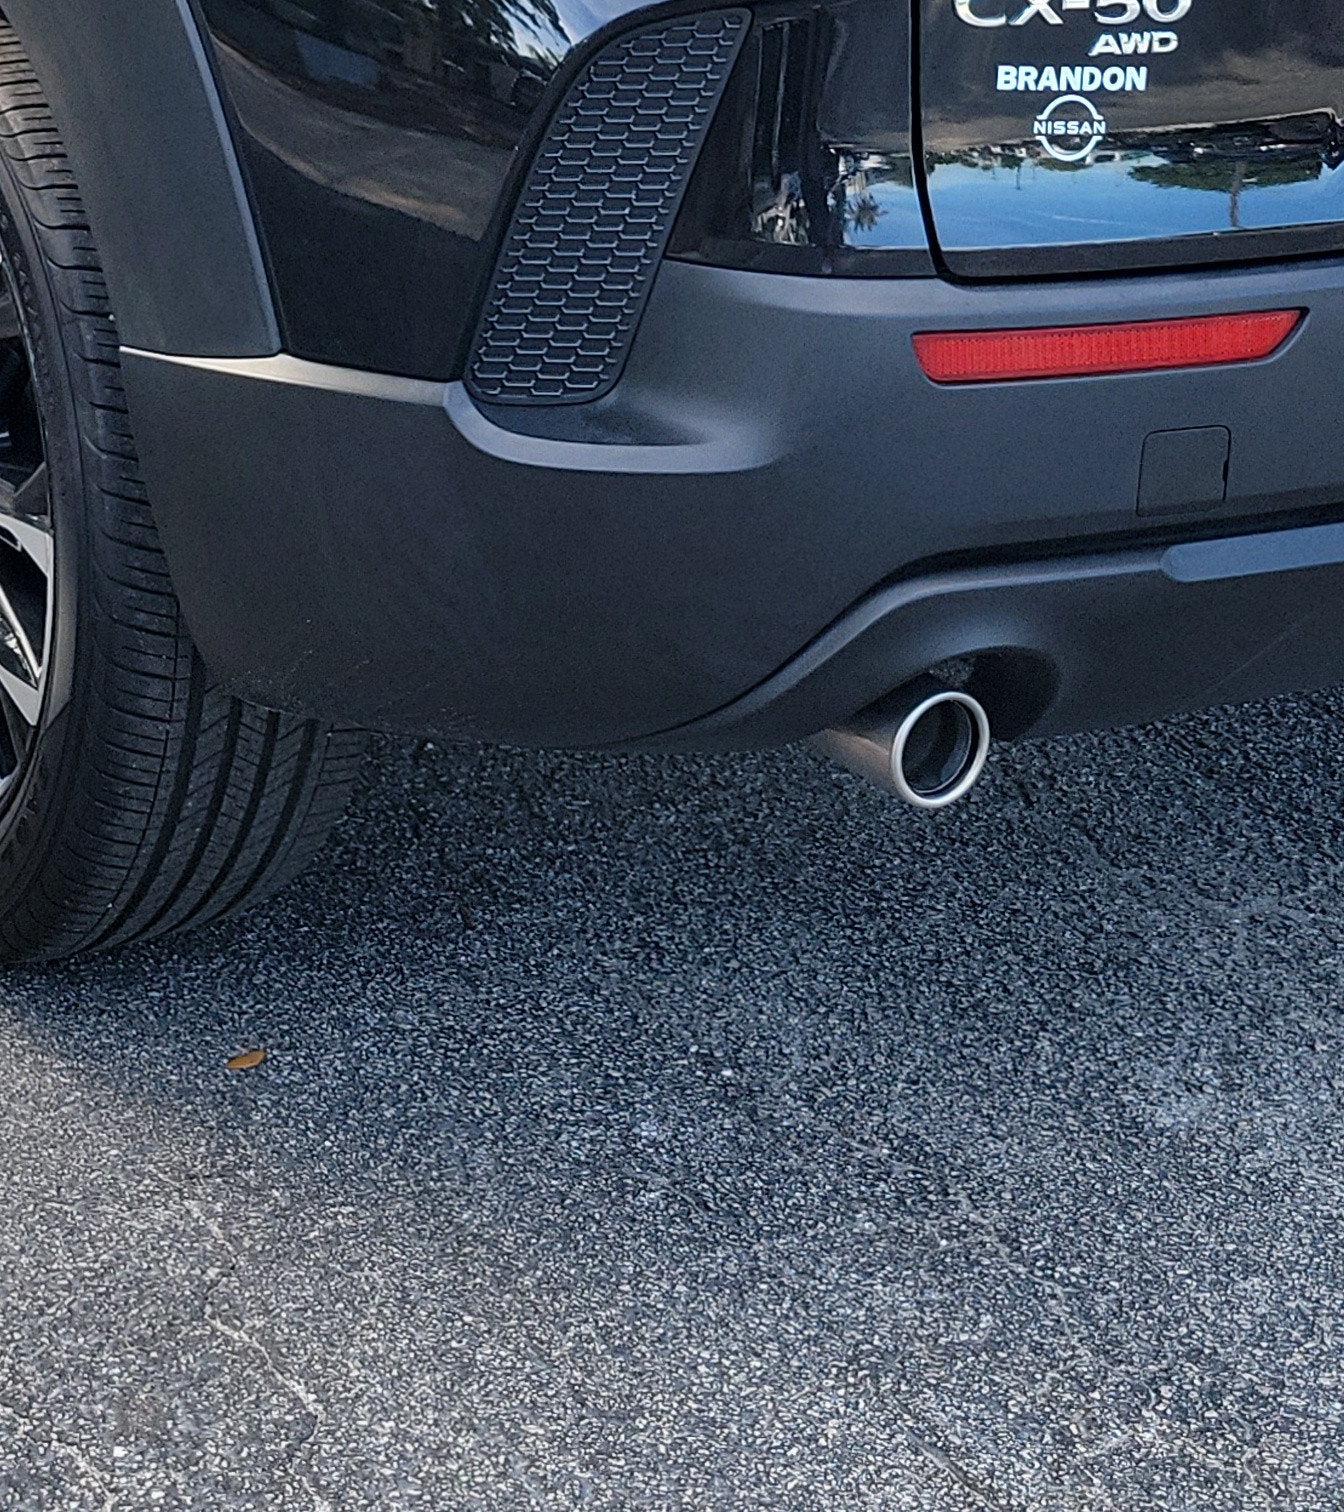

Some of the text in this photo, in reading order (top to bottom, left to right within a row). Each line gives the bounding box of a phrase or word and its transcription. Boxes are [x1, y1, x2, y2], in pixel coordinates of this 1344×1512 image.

[1088, 31, 1179, 57] AWD
[995, 64, 1148, 92] BRANDON
[1032, 119, 1106, 135] NISSAN
